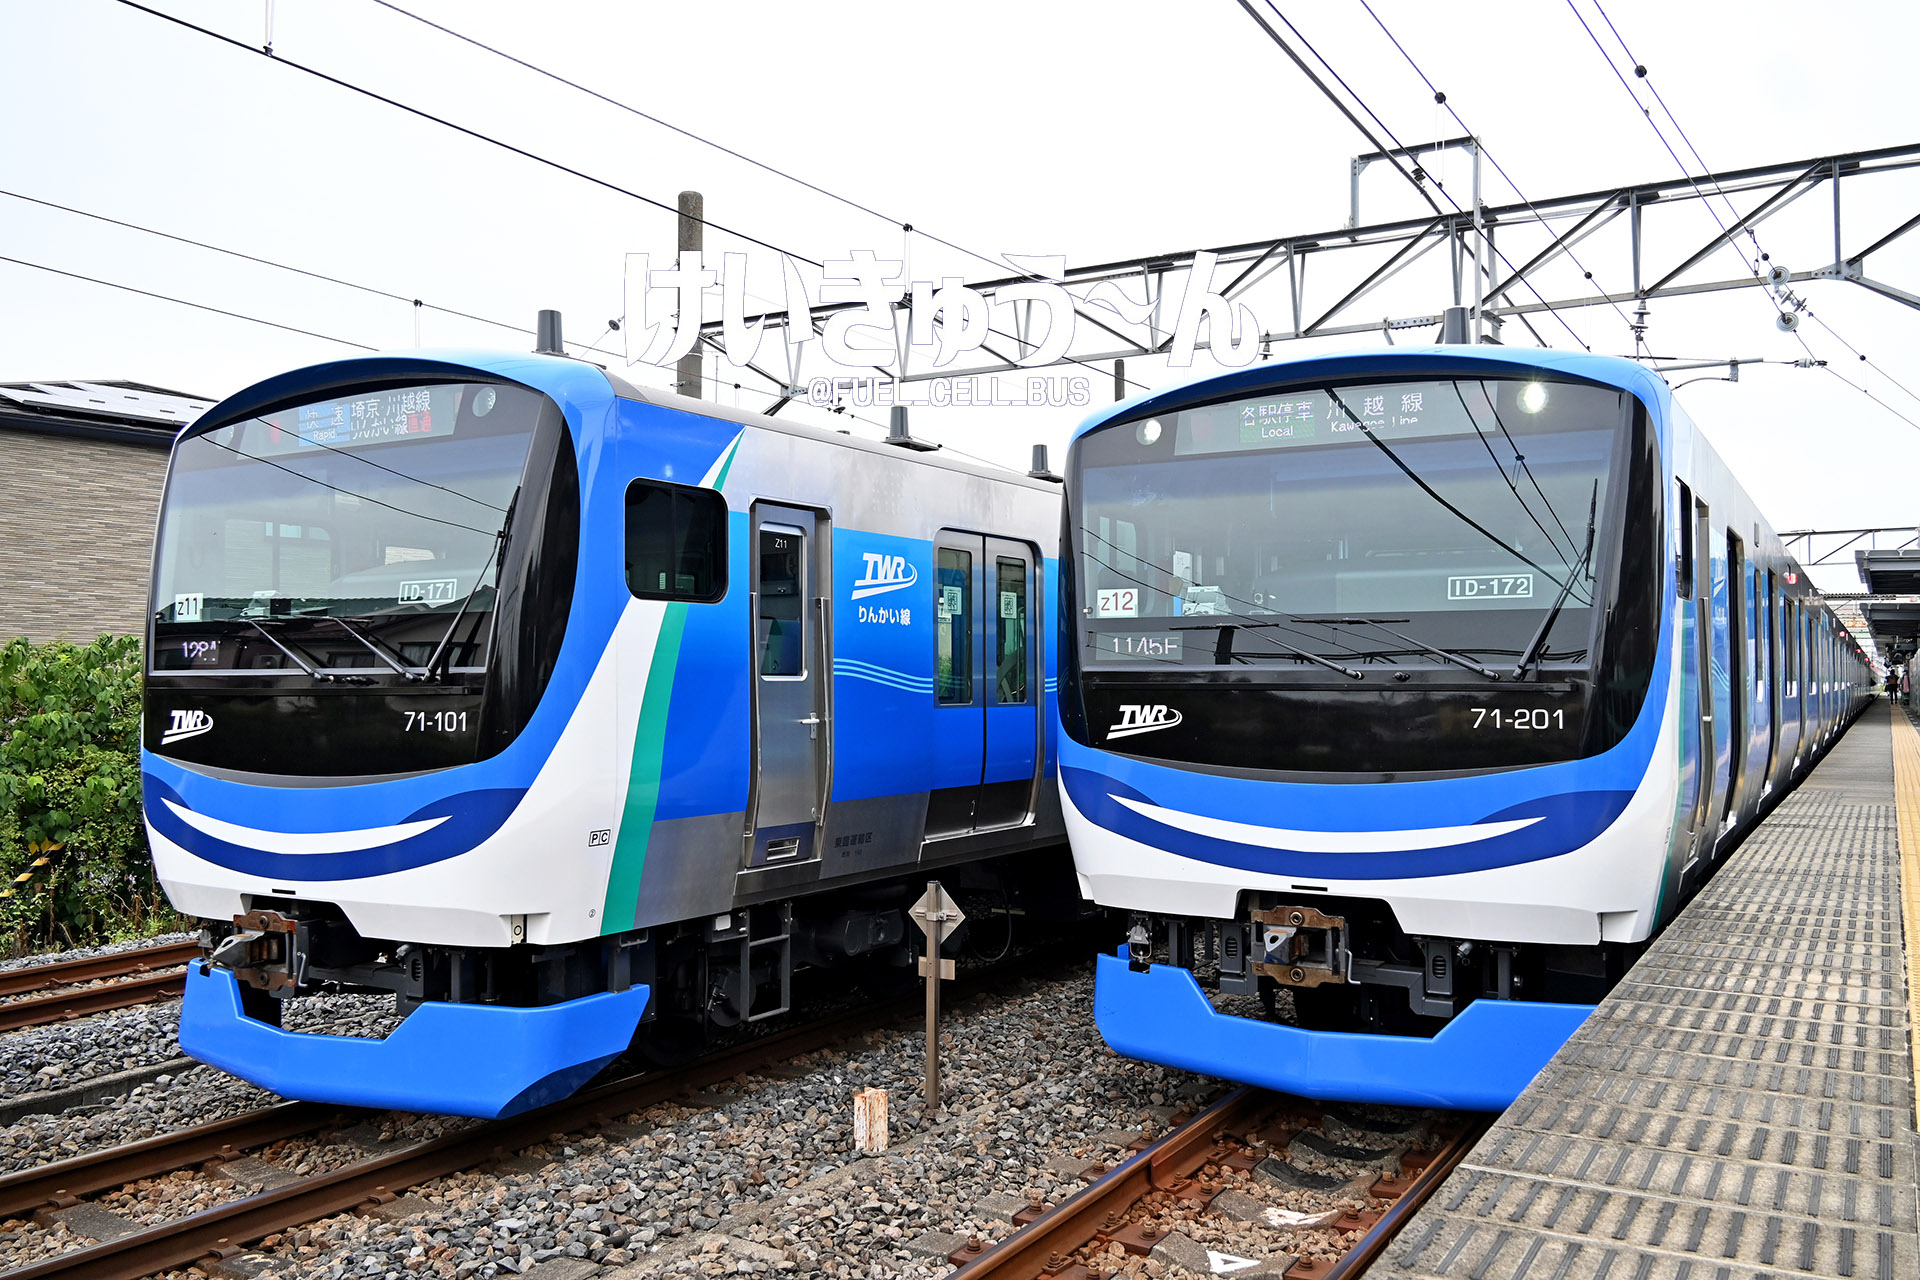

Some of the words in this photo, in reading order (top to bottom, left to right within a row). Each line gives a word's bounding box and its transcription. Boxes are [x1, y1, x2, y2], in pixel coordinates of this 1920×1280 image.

[313, 429, 336, 442] Rapid
[1261, 426, 1294, 438] Local
[775, 538, 787, 549] Z11
[855, 552, 913, 585] TWR
[404, 582, 454, 600] ID-171
[1455, 578, 1529, 596] ID-172
[858, 605, 911, 626] りんかい線
[165, 710, 210, 735] TWR
[403, 711, 467, 732] 71-101
[1113, 705, 1176, 730] TWR
[1470, 708, 1564, 730] 71-201
